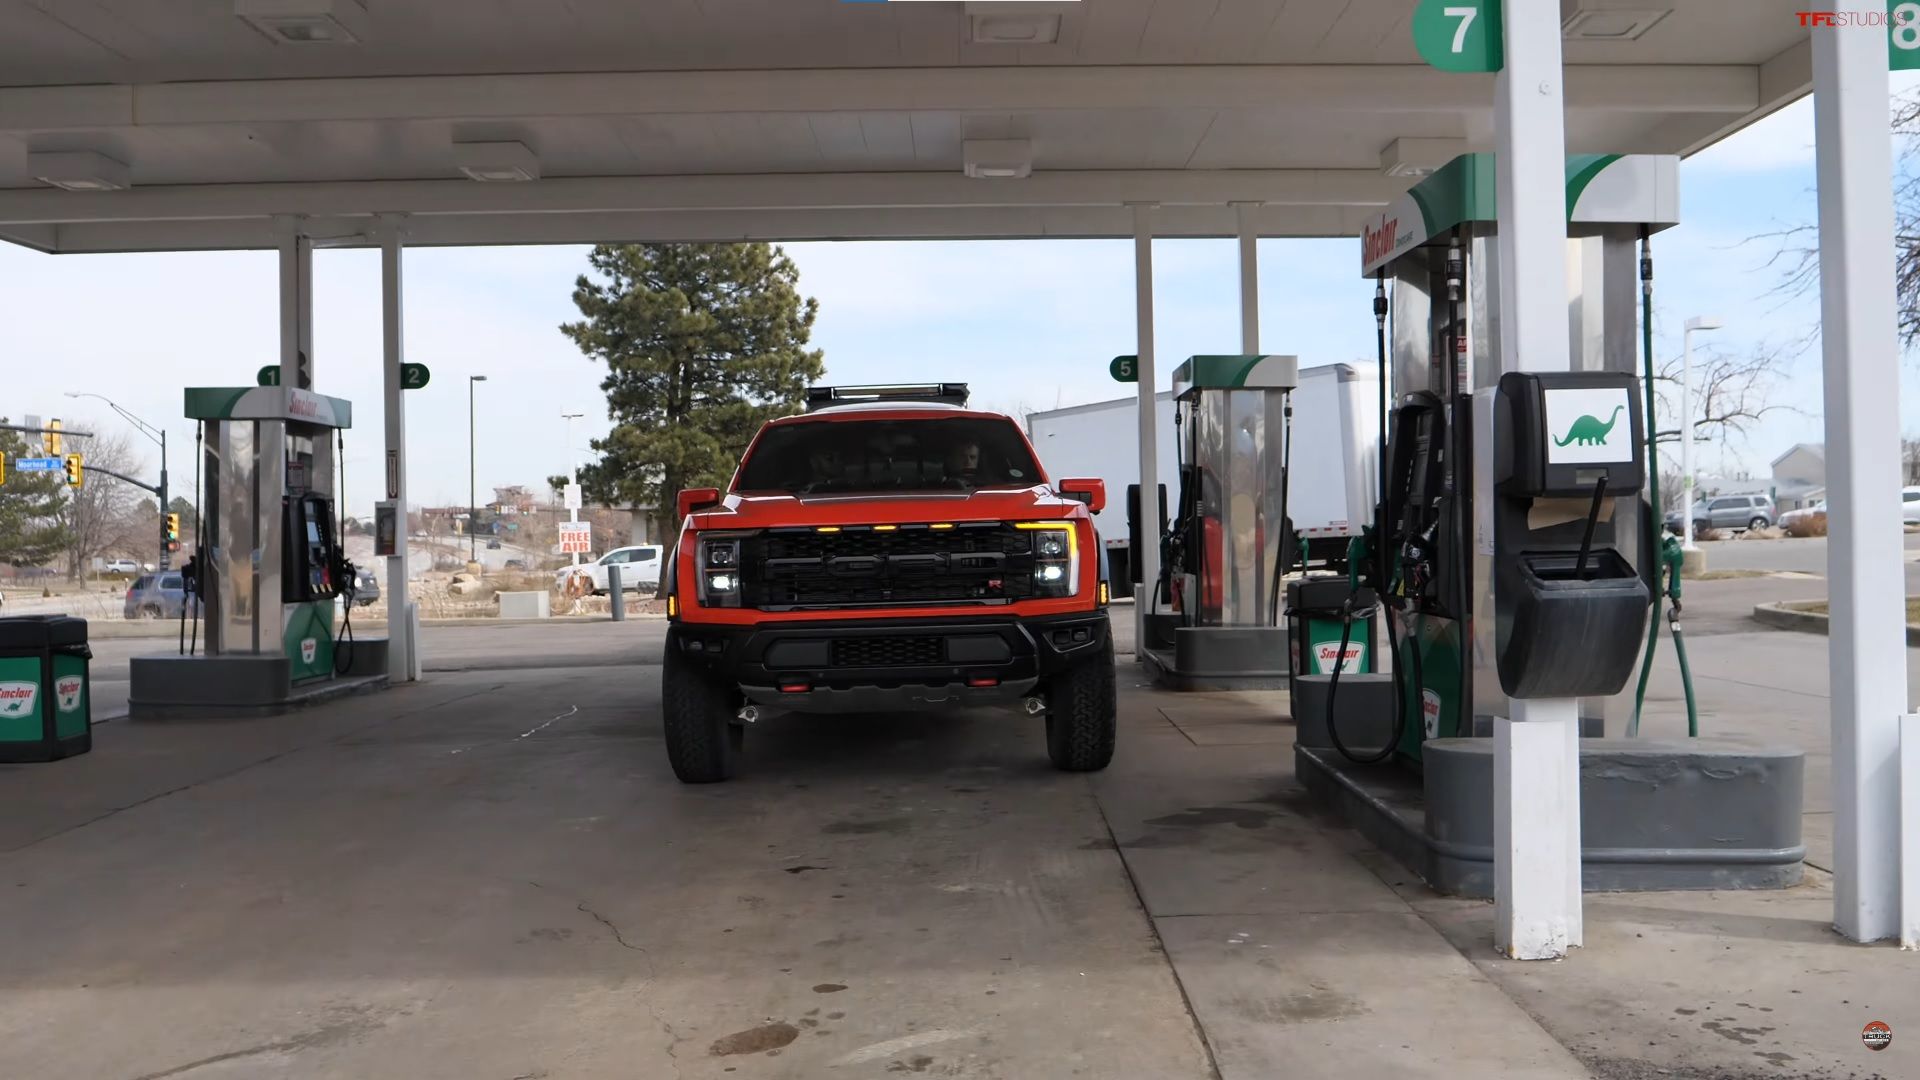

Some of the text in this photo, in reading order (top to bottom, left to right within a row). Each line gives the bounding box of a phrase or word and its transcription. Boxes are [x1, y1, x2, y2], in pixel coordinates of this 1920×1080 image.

[1443, 7, 1478, 53] 7
[1892, 2, 1920, 50] 8
[1364, 214, 1398, 268] Sinclair
[408, 368, 421, 384] 2
[1120, 361, 1132, 377] 5
[267, 370, 275, 385] 1
[289, 391, 318, 417] Sinclair
[561, 532, 590, 542] FREE
[562, 542, 589, 552] AIR
[988, 579, 1003, 589] R
[1320, 647, 1360, 660] Sinair
